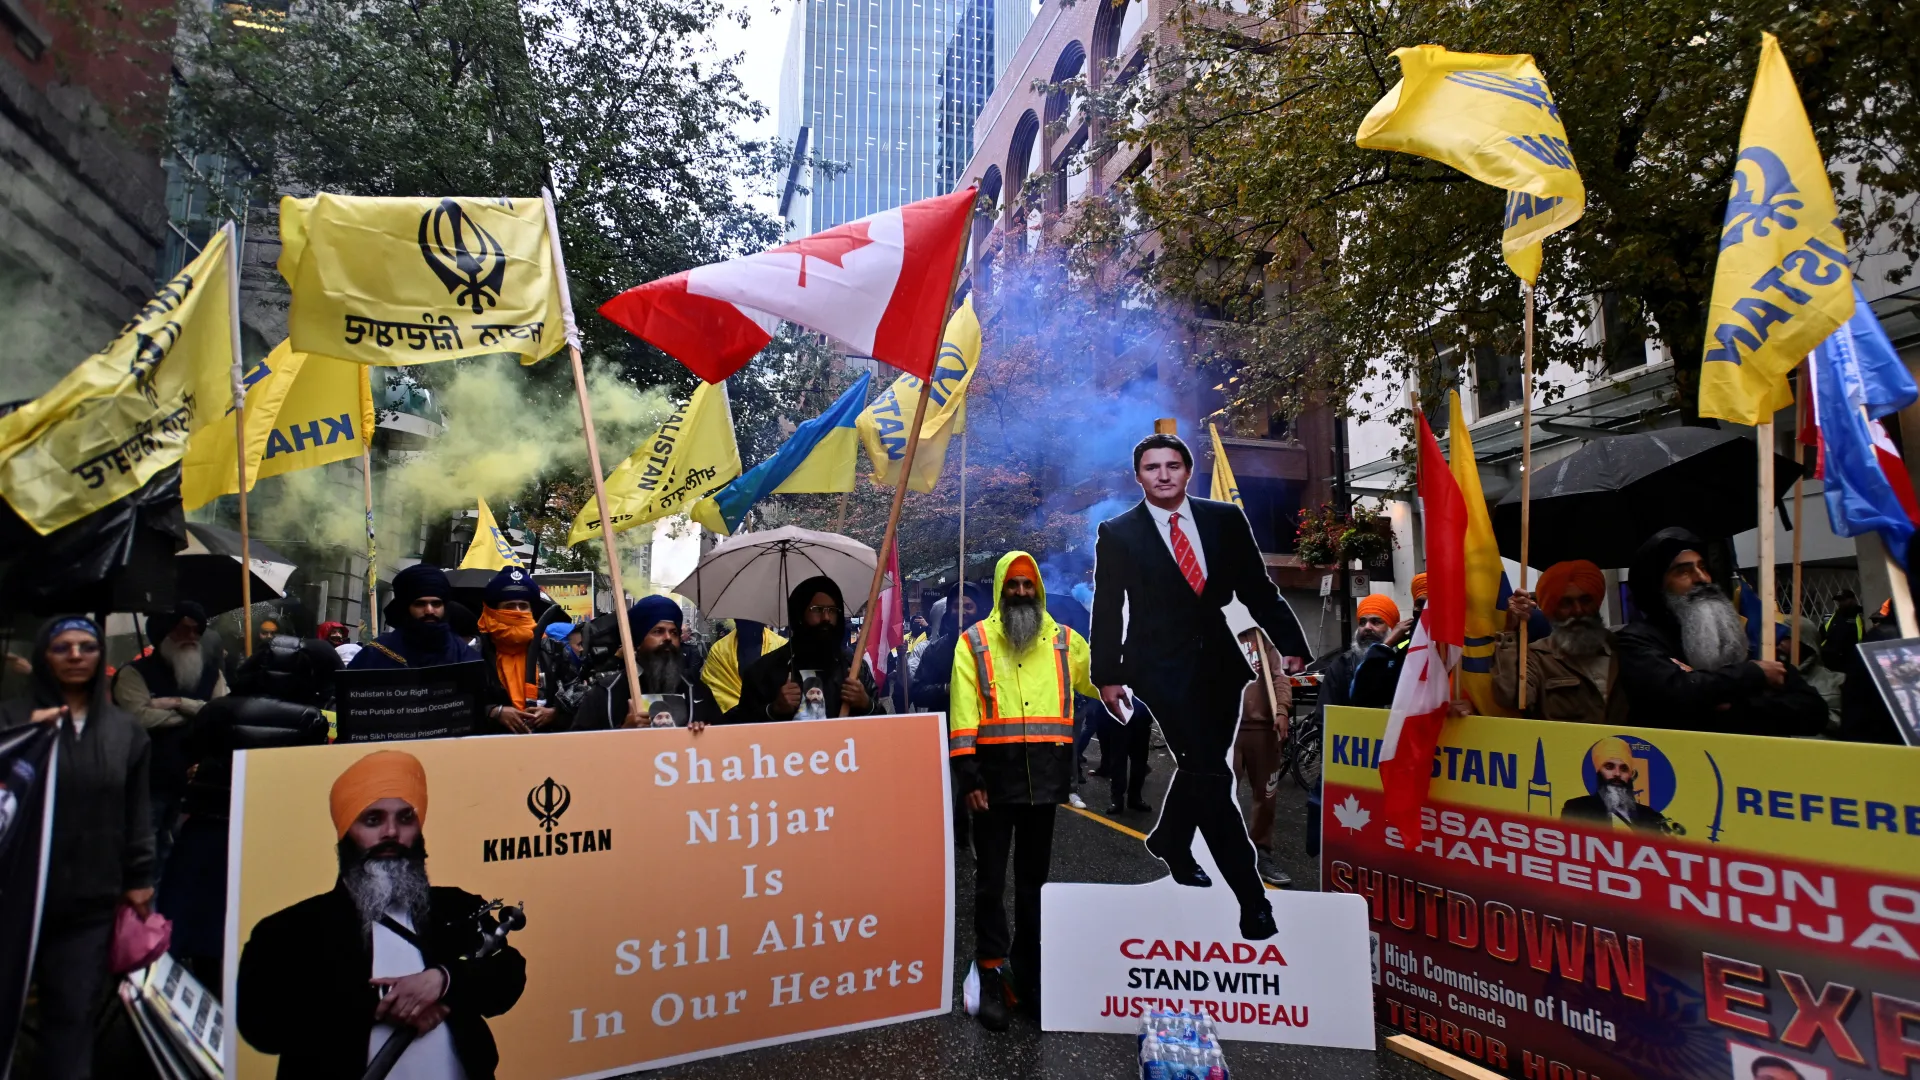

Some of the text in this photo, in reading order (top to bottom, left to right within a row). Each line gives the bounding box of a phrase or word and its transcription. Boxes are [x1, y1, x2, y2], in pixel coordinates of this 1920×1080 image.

[369, 708, 395, 716] Punjab
[406, 706, 427, 714] Indian
[428, 700, 465, 711] Occupation
[410, 688, 429, 697] Right
[418, 727, 448, 738] Prisoners
[653, 738, 860, 787] Shaheed
[483, 828, 612, 863] KHALISTAN
[686, 800, 835, 849] Nijjar
[742, 864, 784, 899] Is
[1418, 806, 1837, 909] SSASSINATION
[615, 911, 879, 977] Still Alive
[1119, 938, 1288, 967] CANADA
[1331, 860, 1647, 1002] SHUTDOWN
[568, 959, 925, 1043] In Our Hearts
[1127, 968, 1281, 996] STAND WITH
[1384, 942, 1418, 976] High
[1423, 956, 1528, 1012] Commission
[1534, 996, 1555, 1021] of
[1561, 1000, 1617, 1042] India
[1385, 970, 1443, 1008] Ottawa,
[1448, 993, 1507, 1029] Canada
[1101, 996, 1310, 1028] JUSTIN TRUDEAU
[1386, 998, 1510, 1070] TERROR
